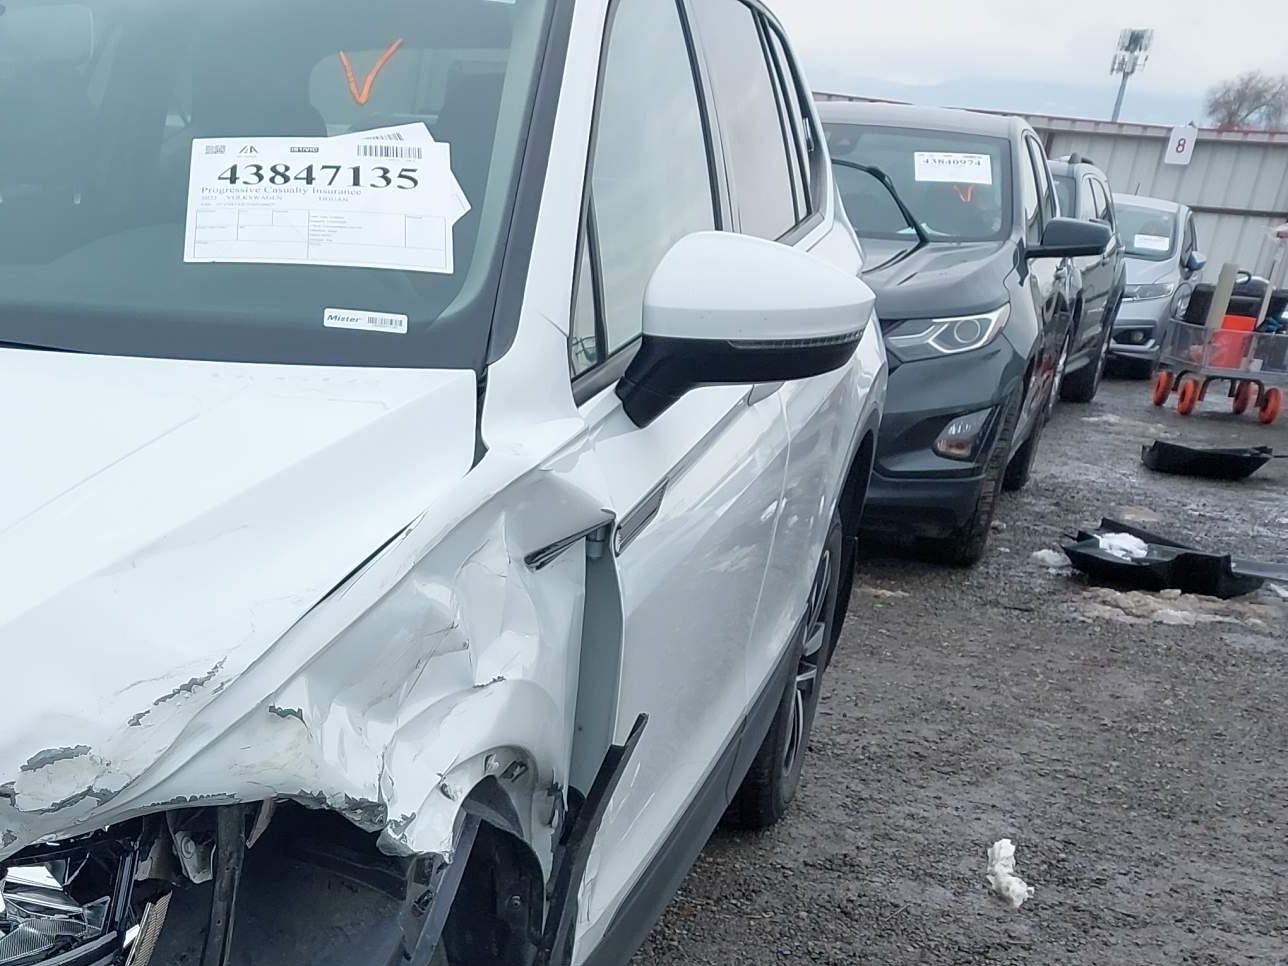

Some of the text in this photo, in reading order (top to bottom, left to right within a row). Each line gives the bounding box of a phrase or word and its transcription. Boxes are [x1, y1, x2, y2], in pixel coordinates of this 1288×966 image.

[1175, 138, 1186, 153] 8
[217, 163, 419, 189] 43847135
[200, 186, 362, 197] Progressive Casualty Insurance
[327, 315, 360, 323] Mister
